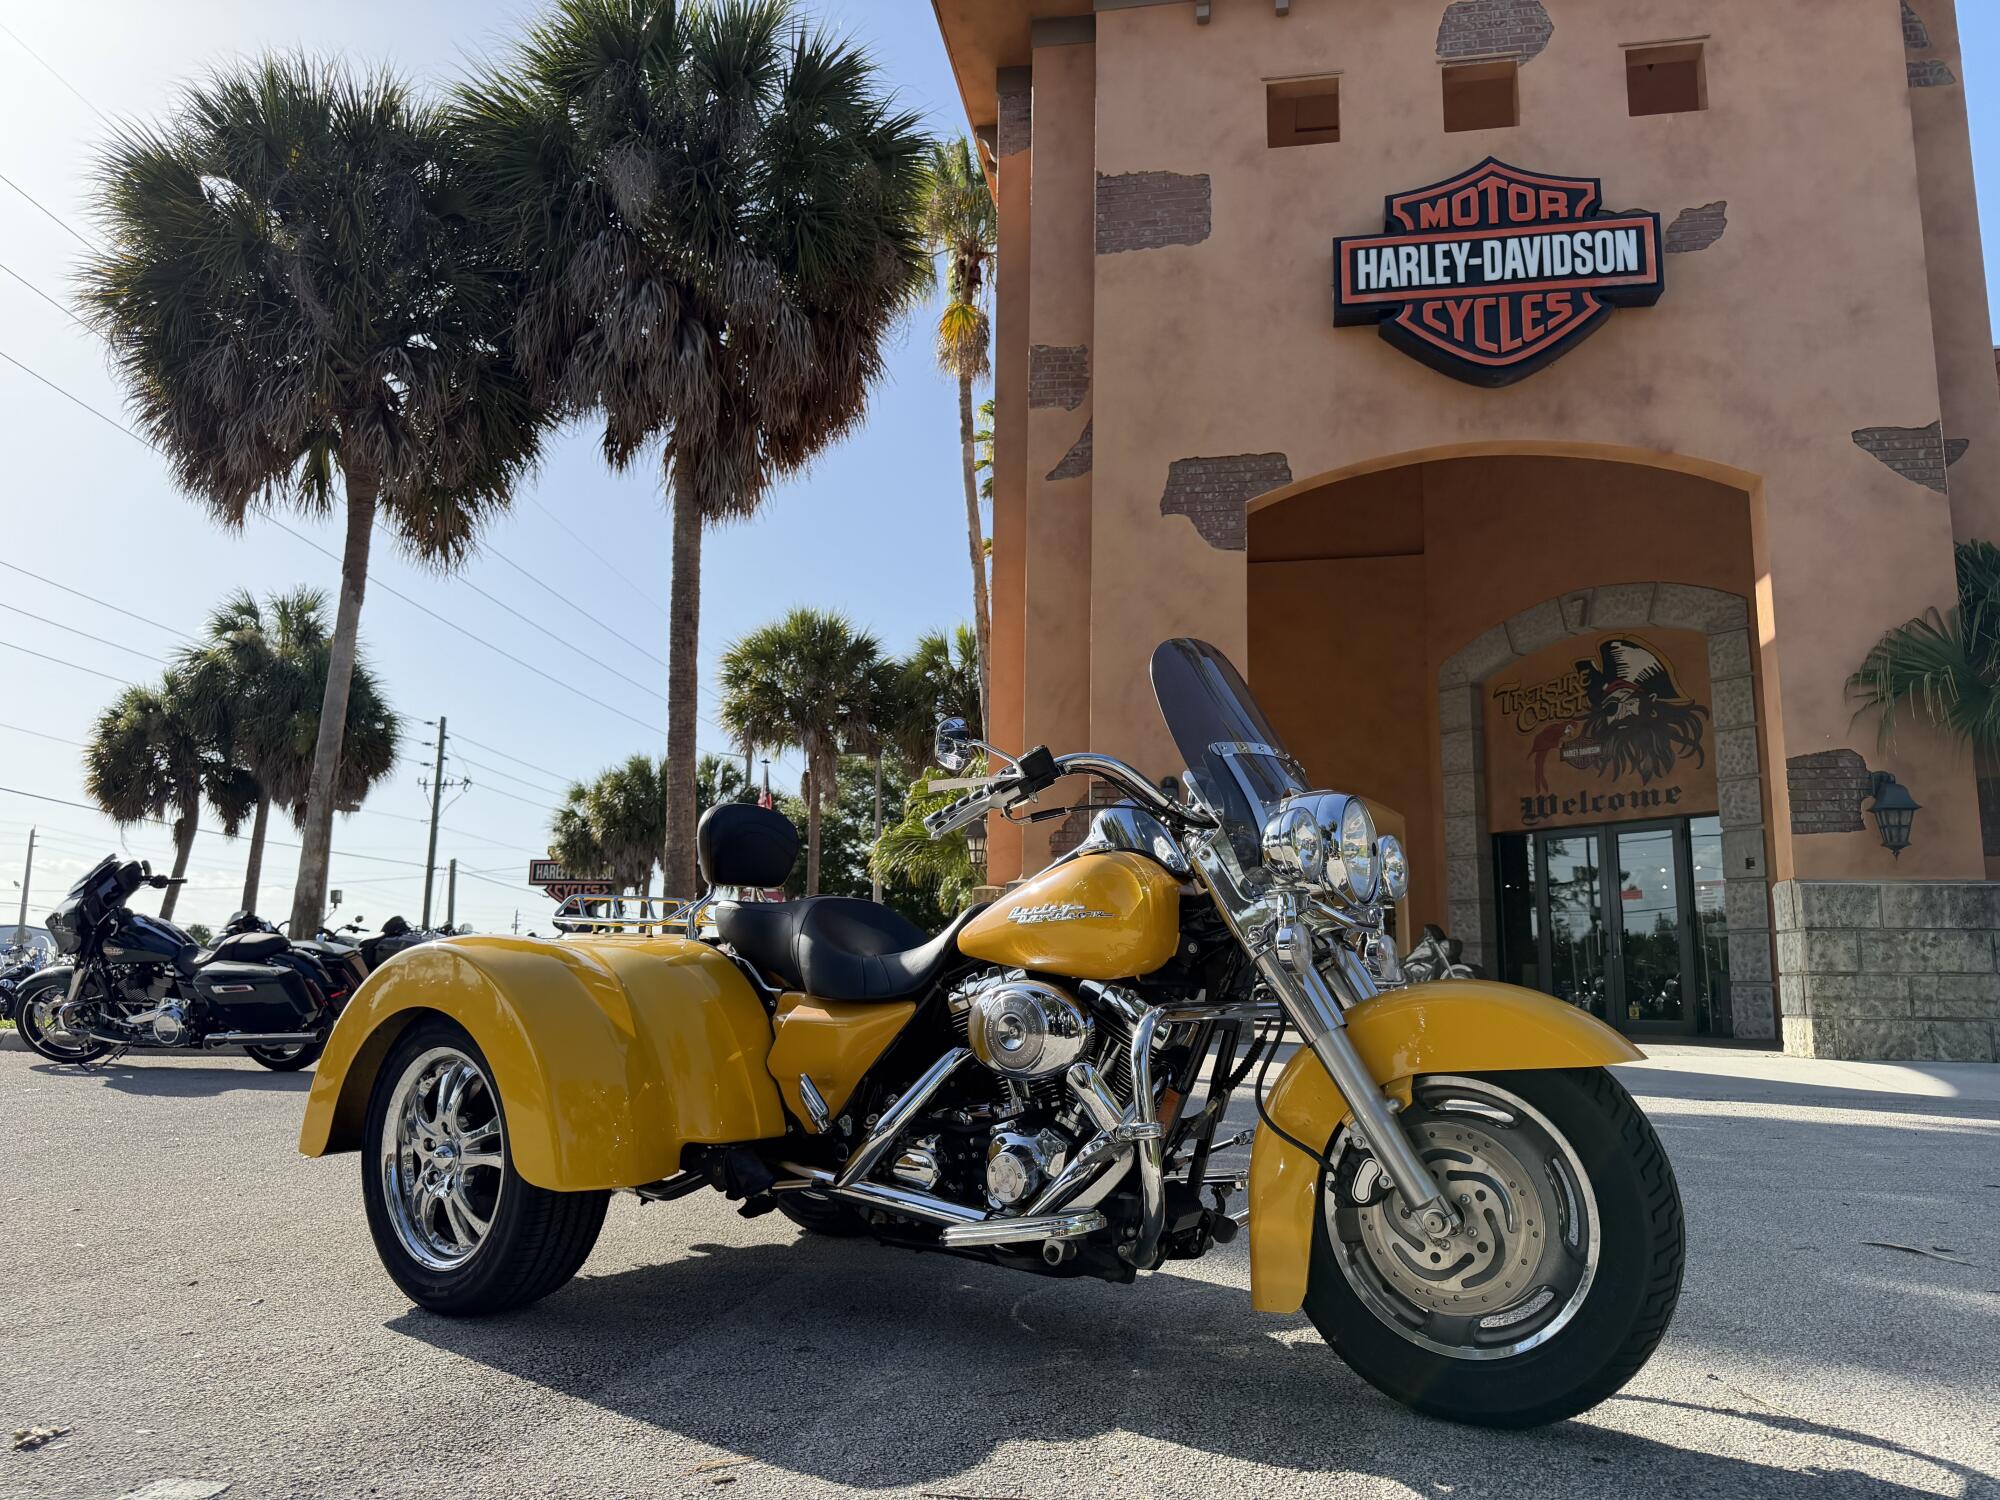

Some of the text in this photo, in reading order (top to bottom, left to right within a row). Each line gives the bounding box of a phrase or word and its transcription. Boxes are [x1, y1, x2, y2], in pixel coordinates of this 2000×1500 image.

[1419, 176, 1569, 229] MOTOR
[1356, 230, 1639, 291] HARLEY-DAVIDSON
[1421, 291, 1573, 354] CYCLES
[1519, 785, 1682, 826] Welcome
